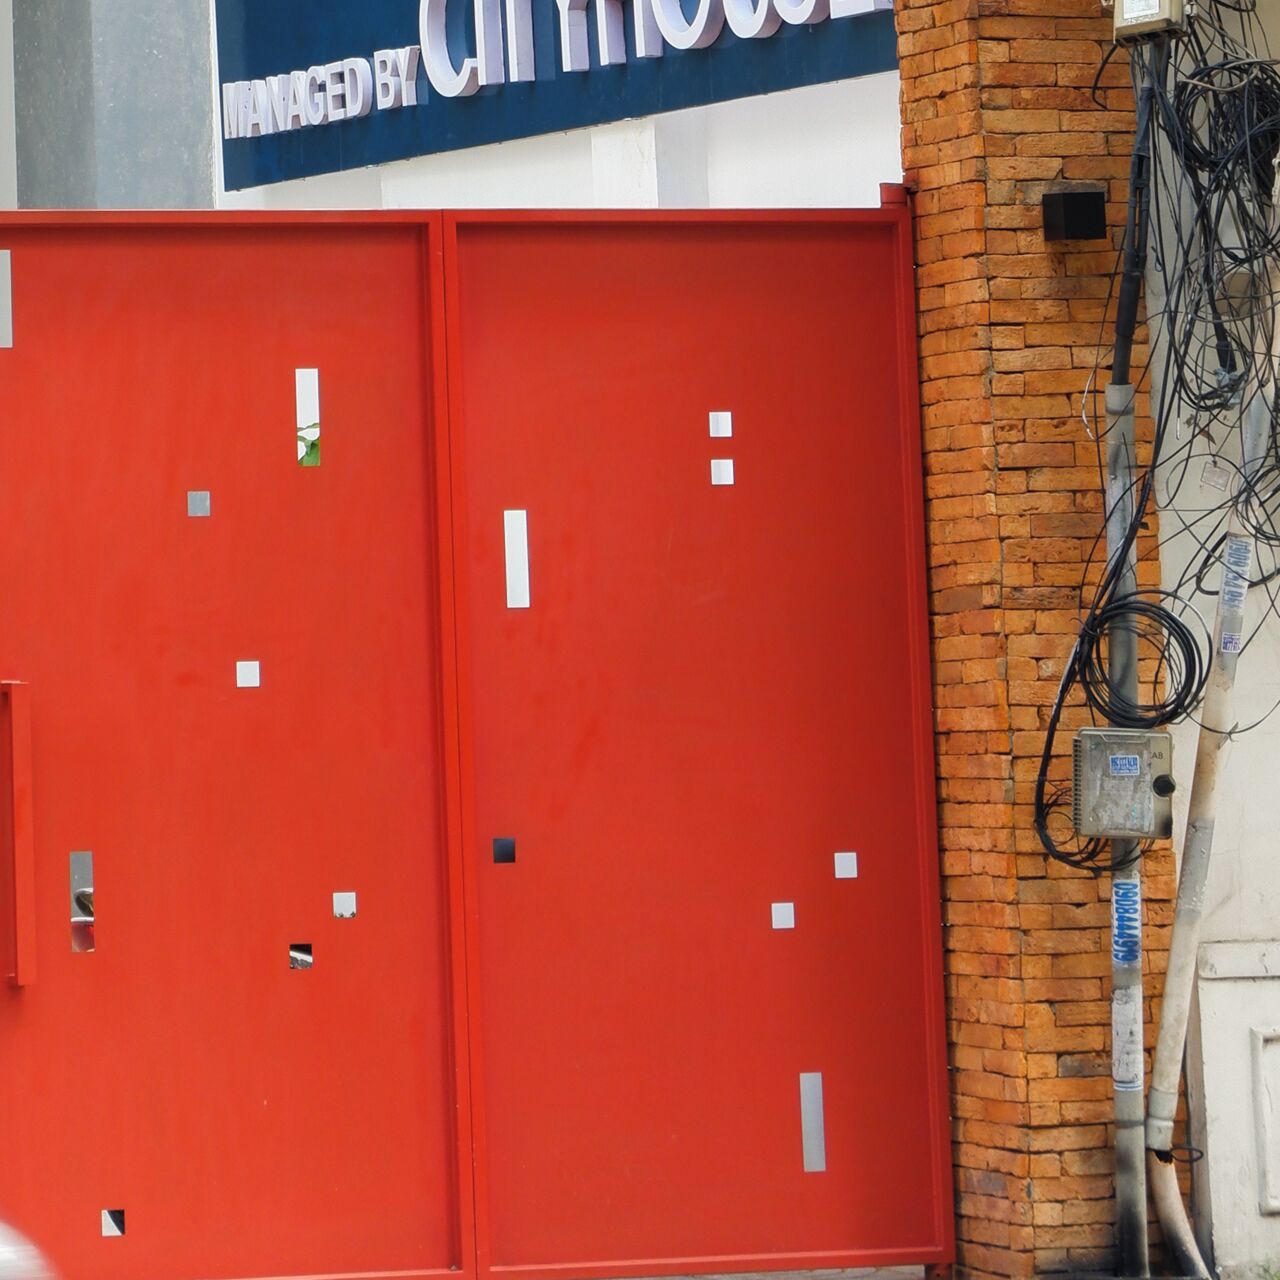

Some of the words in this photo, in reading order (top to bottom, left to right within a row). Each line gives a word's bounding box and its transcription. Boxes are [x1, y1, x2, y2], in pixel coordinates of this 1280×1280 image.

[223, 57, 372, 139] MANAGED
[373, 45, 420, 110] BY
[1149, 751, 1164, 760] AB
